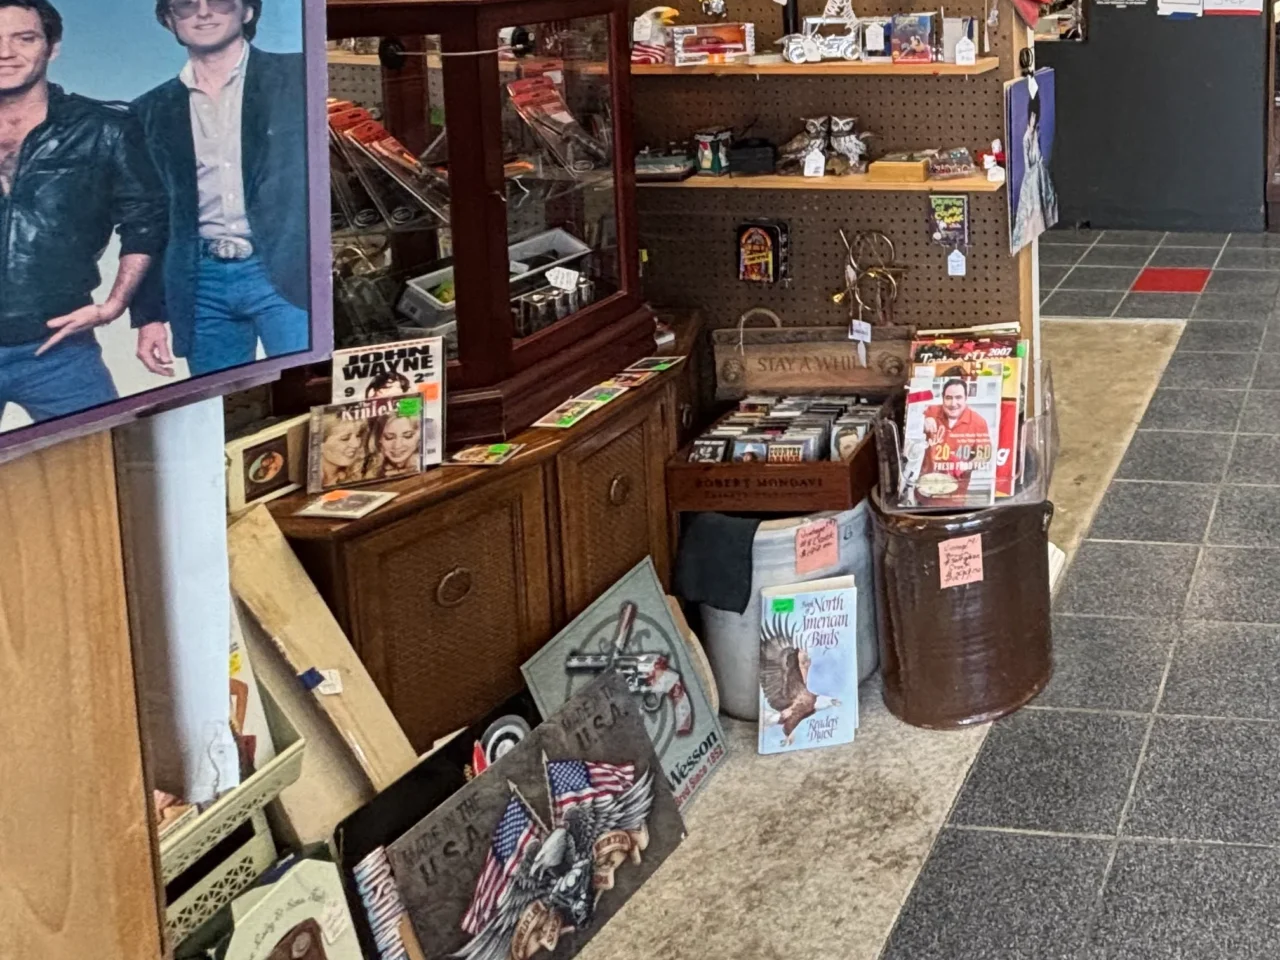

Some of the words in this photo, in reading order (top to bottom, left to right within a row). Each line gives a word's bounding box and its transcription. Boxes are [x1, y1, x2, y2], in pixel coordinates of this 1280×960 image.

[345, 344, 431, 367] JOHN
[987, 347, 1013, 356] 2007
[342, 354, 433, 381] WAYNE
[757, 356, 795, 372] STAY
[800, 356, 813, 372] A
[344, 386, 355, 397] 9
[933, 461, 955, 471] FRESH
[695, 477, 751, 489] ROBERT
[756, 477, 823, 488] MONDAVI
[814, 593, 844, 614] North
[796, 613, 849, 632] American
[807, 629, 840, 652] Birds
